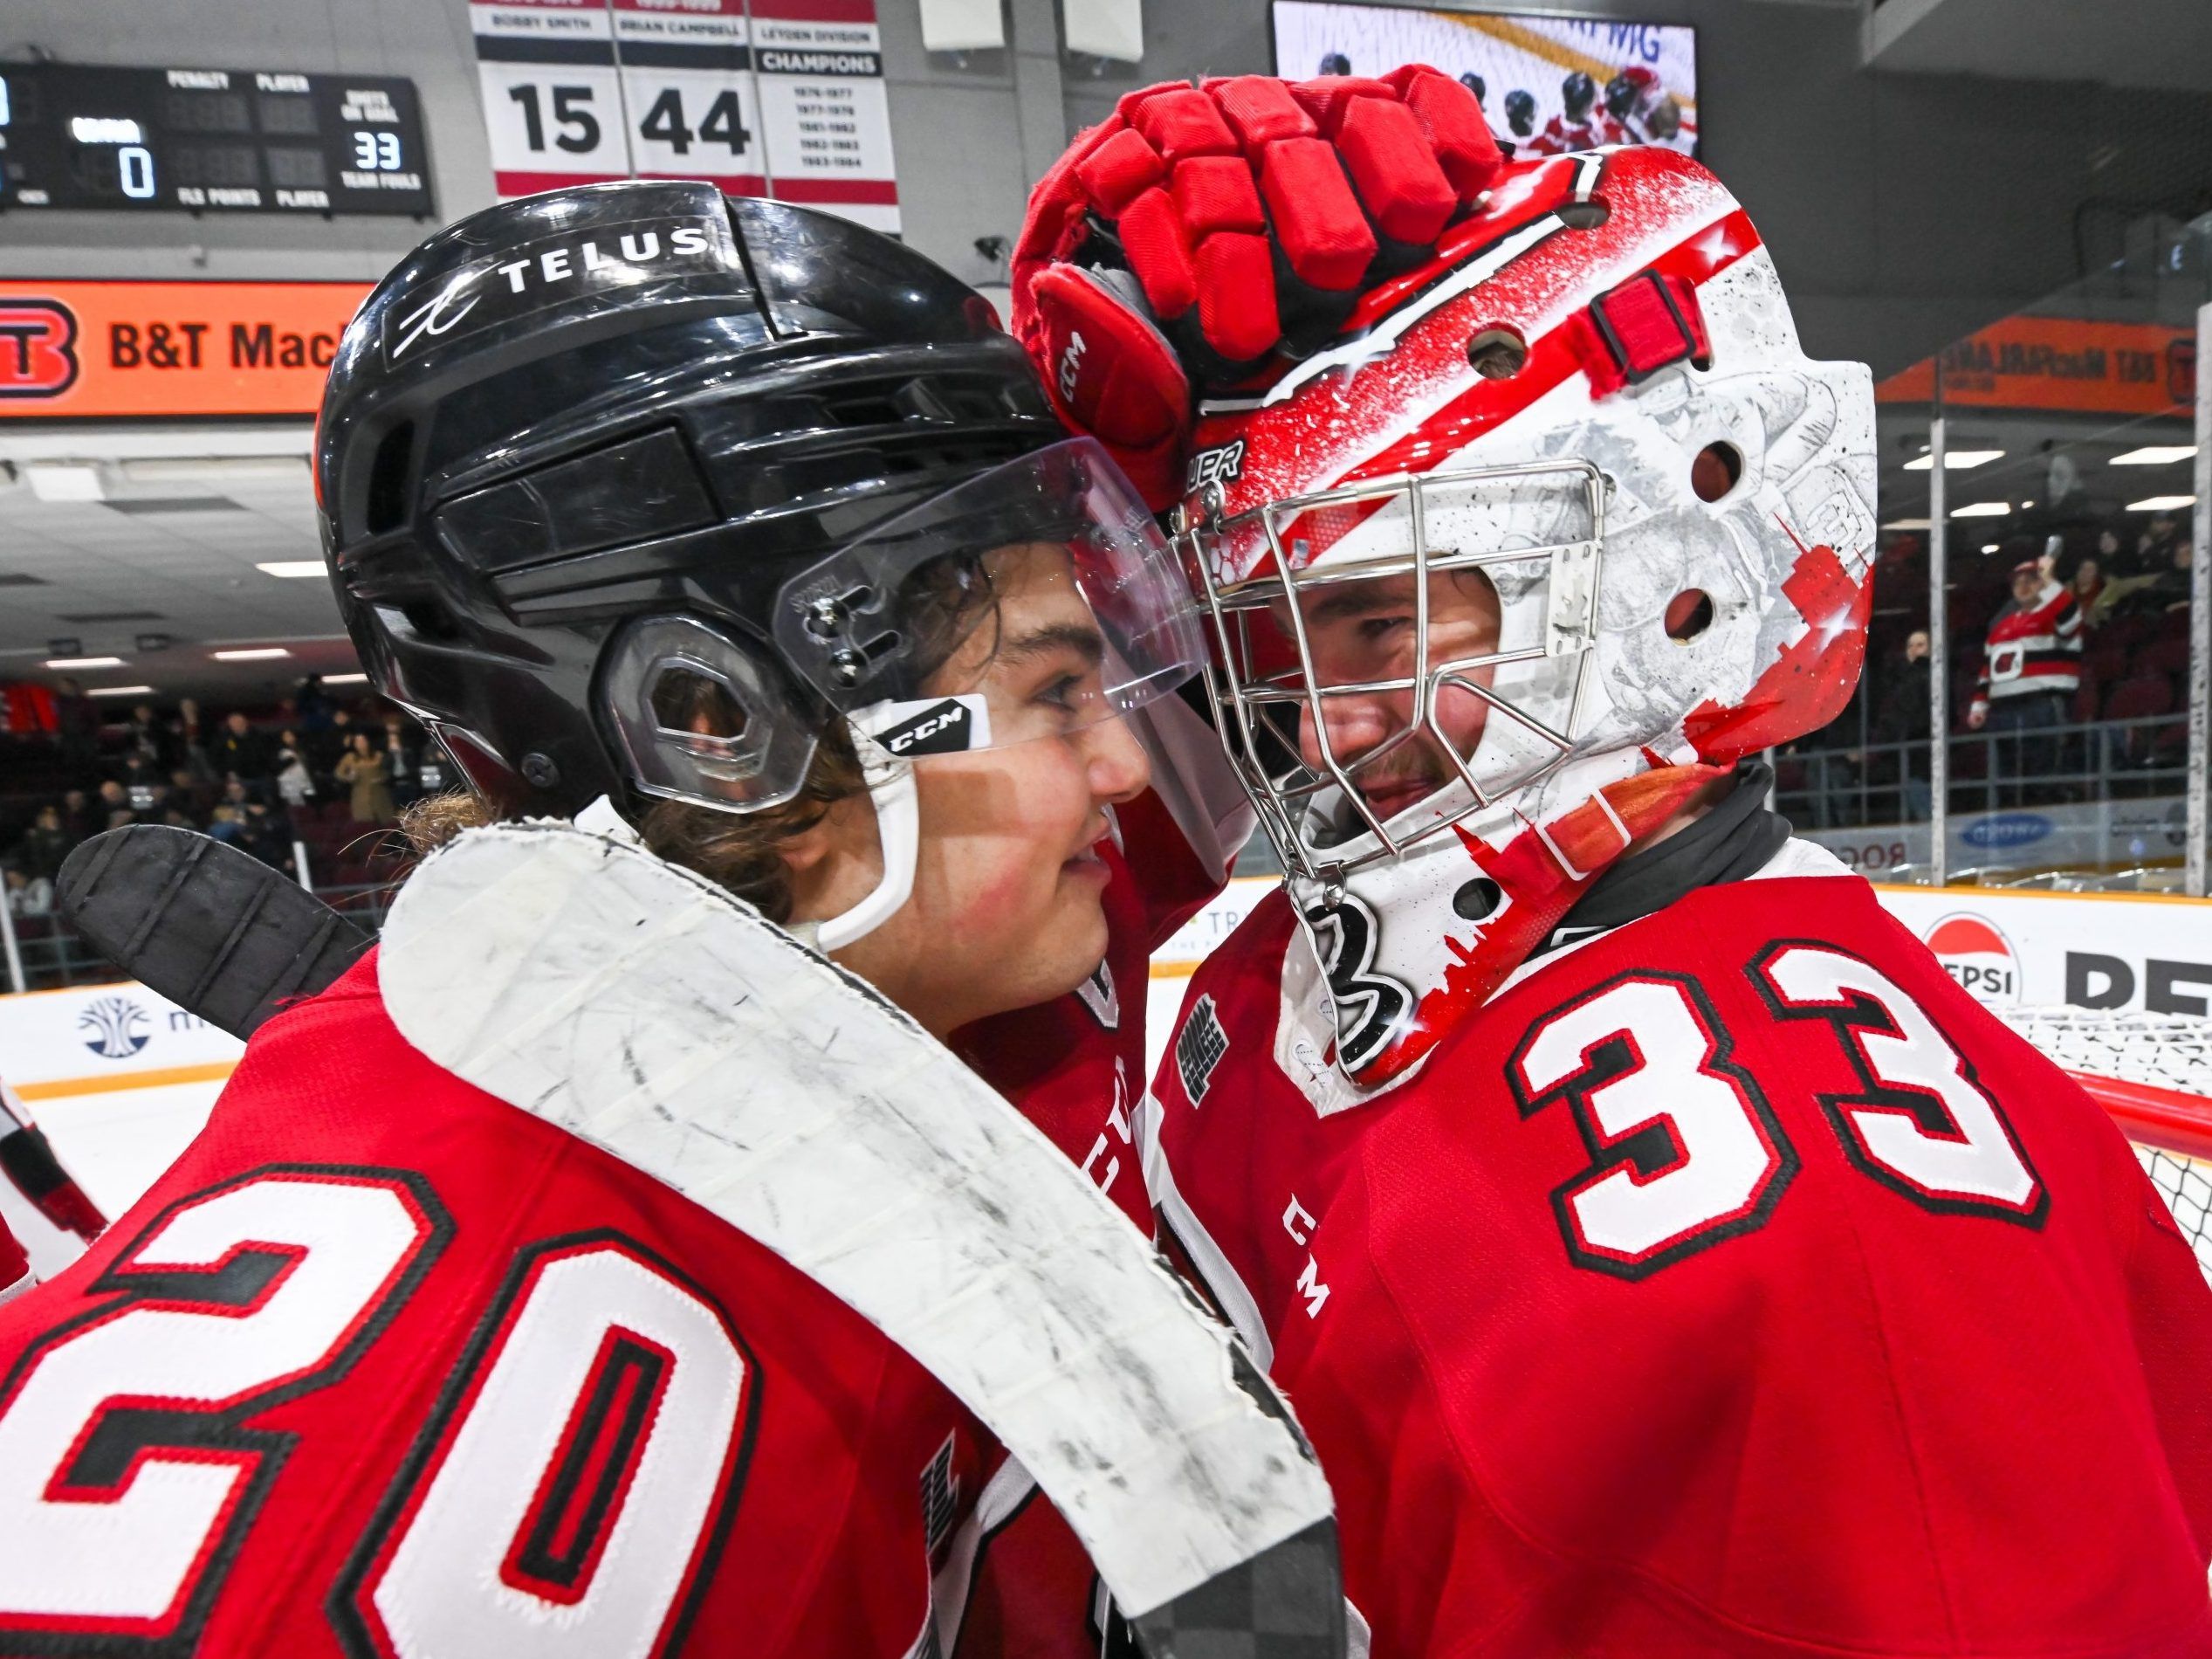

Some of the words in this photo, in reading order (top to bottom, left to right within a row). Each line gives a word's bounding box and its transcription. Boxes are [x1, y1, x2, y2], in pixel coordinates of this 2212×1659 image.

[761, 52, 876, 73] CHAMPIONS
[354, 131, 402, 170] 33
[508, 84, 601, 154] 15
[640, 88, 751, 155] 44
[119, 147, 155, 198] 0
[498, 228, 709, 294] TELUS
[110, 324, 208, 368] B&T
[231, 322, 348, 368] Mac
[1059, 331, 1086, 403] CCM
[890, 706, 963, 753] CCM
[1504, 938, 2051, 1284] 33
[0, 1162, 764, 1659] 20
